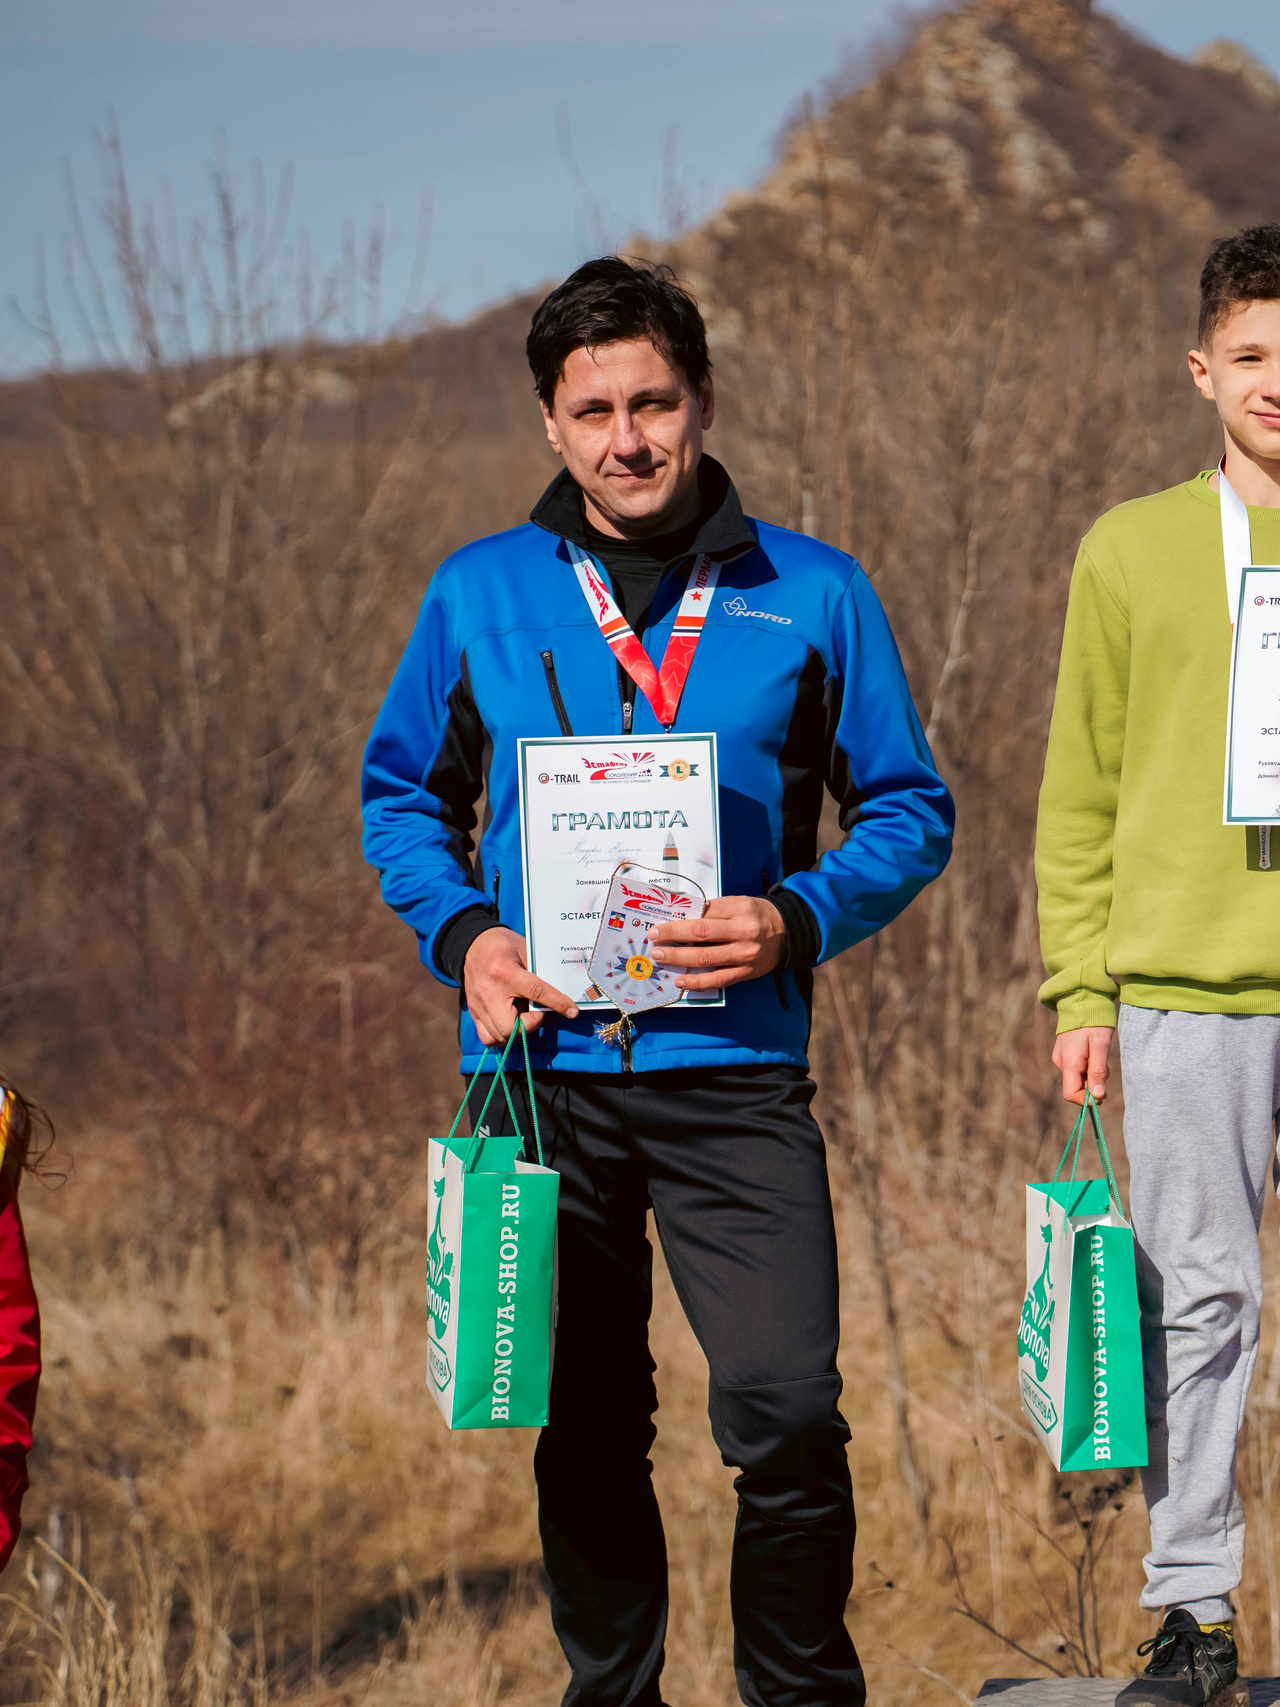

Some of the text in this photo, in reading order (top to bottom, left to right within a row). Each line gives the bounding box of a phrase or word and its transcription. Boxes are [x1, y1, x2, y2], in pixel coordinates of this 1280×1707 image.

[735, 611, 792, 625] NORD
[552, 809, 689, 831] ГРАМОТА
[560, 911, 601, 921] ЭСТАФЕТ
[623, 997, 636, 1005] 2026
[491, 1183, 521, 1421] BIONOVA-SHOP.RU
[1090, 1234, 1111, 1461] BIONOVA-SHOP.RU
